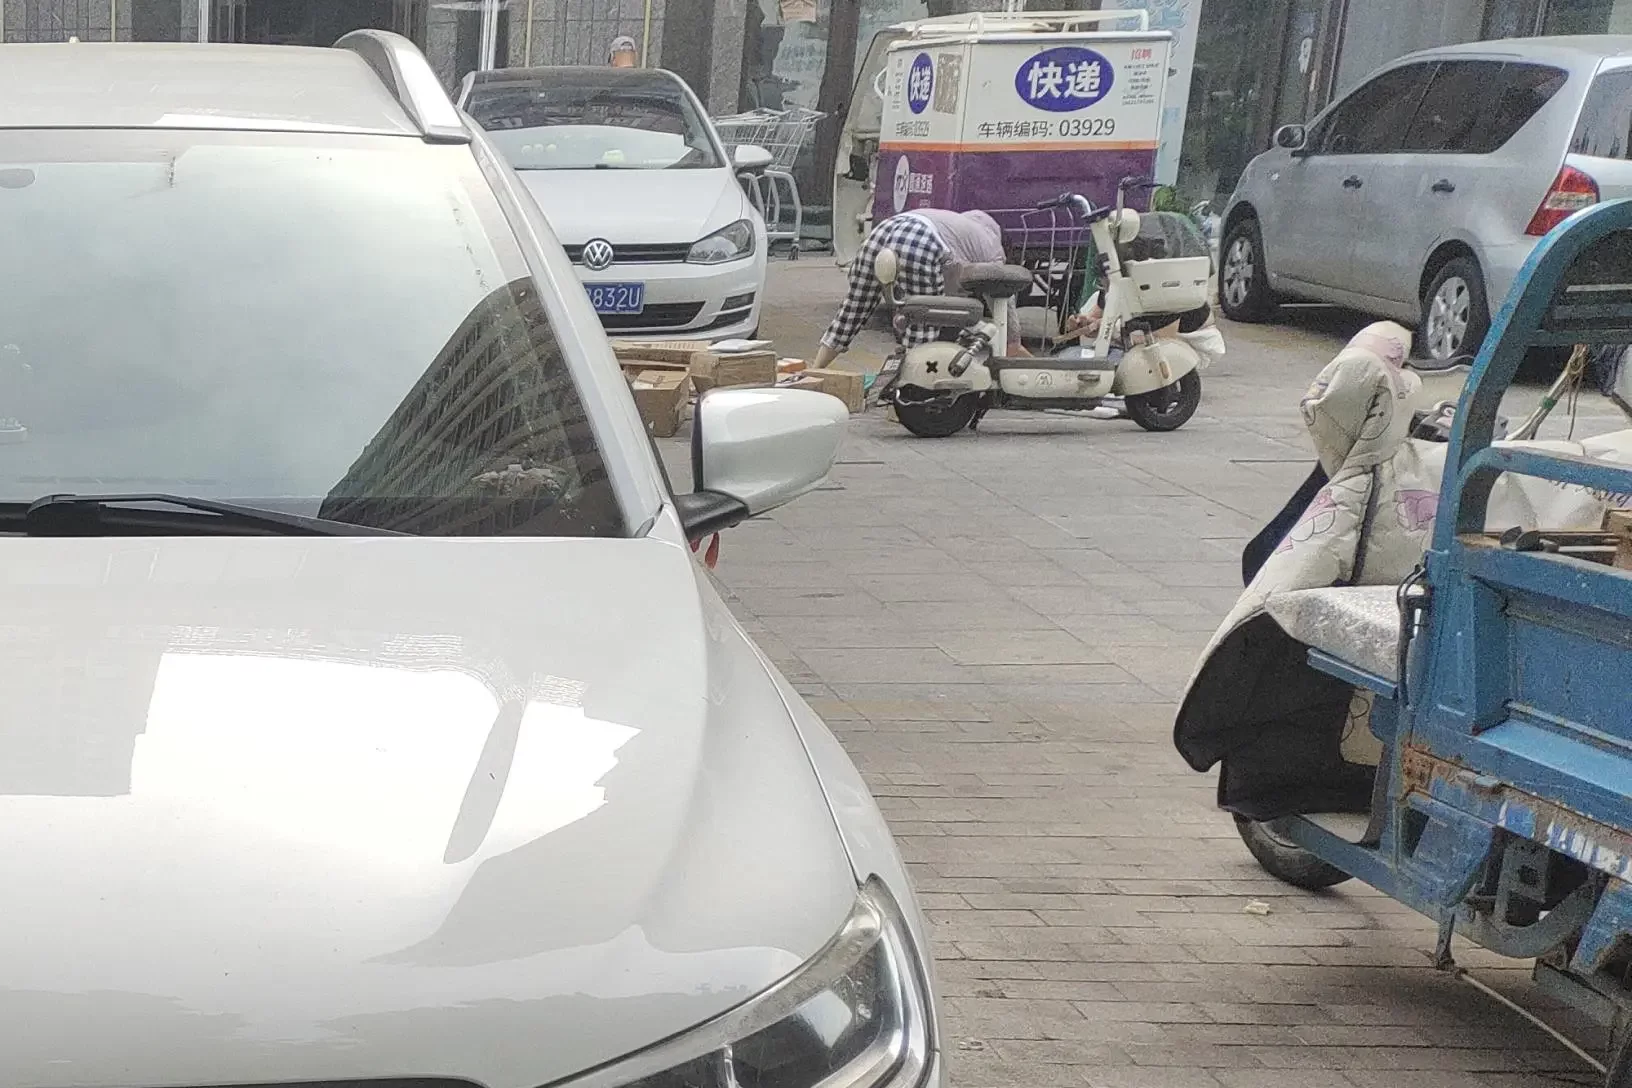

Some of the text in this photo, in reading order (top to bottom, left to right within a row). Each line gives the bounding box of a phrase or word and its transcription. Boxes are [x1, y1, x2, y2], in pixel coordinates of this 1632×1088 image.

[910, 65, 931, 101] 快递
[1028, 60, 1101, 99] 快递
[1059, 118, 1115, 137] 03929
